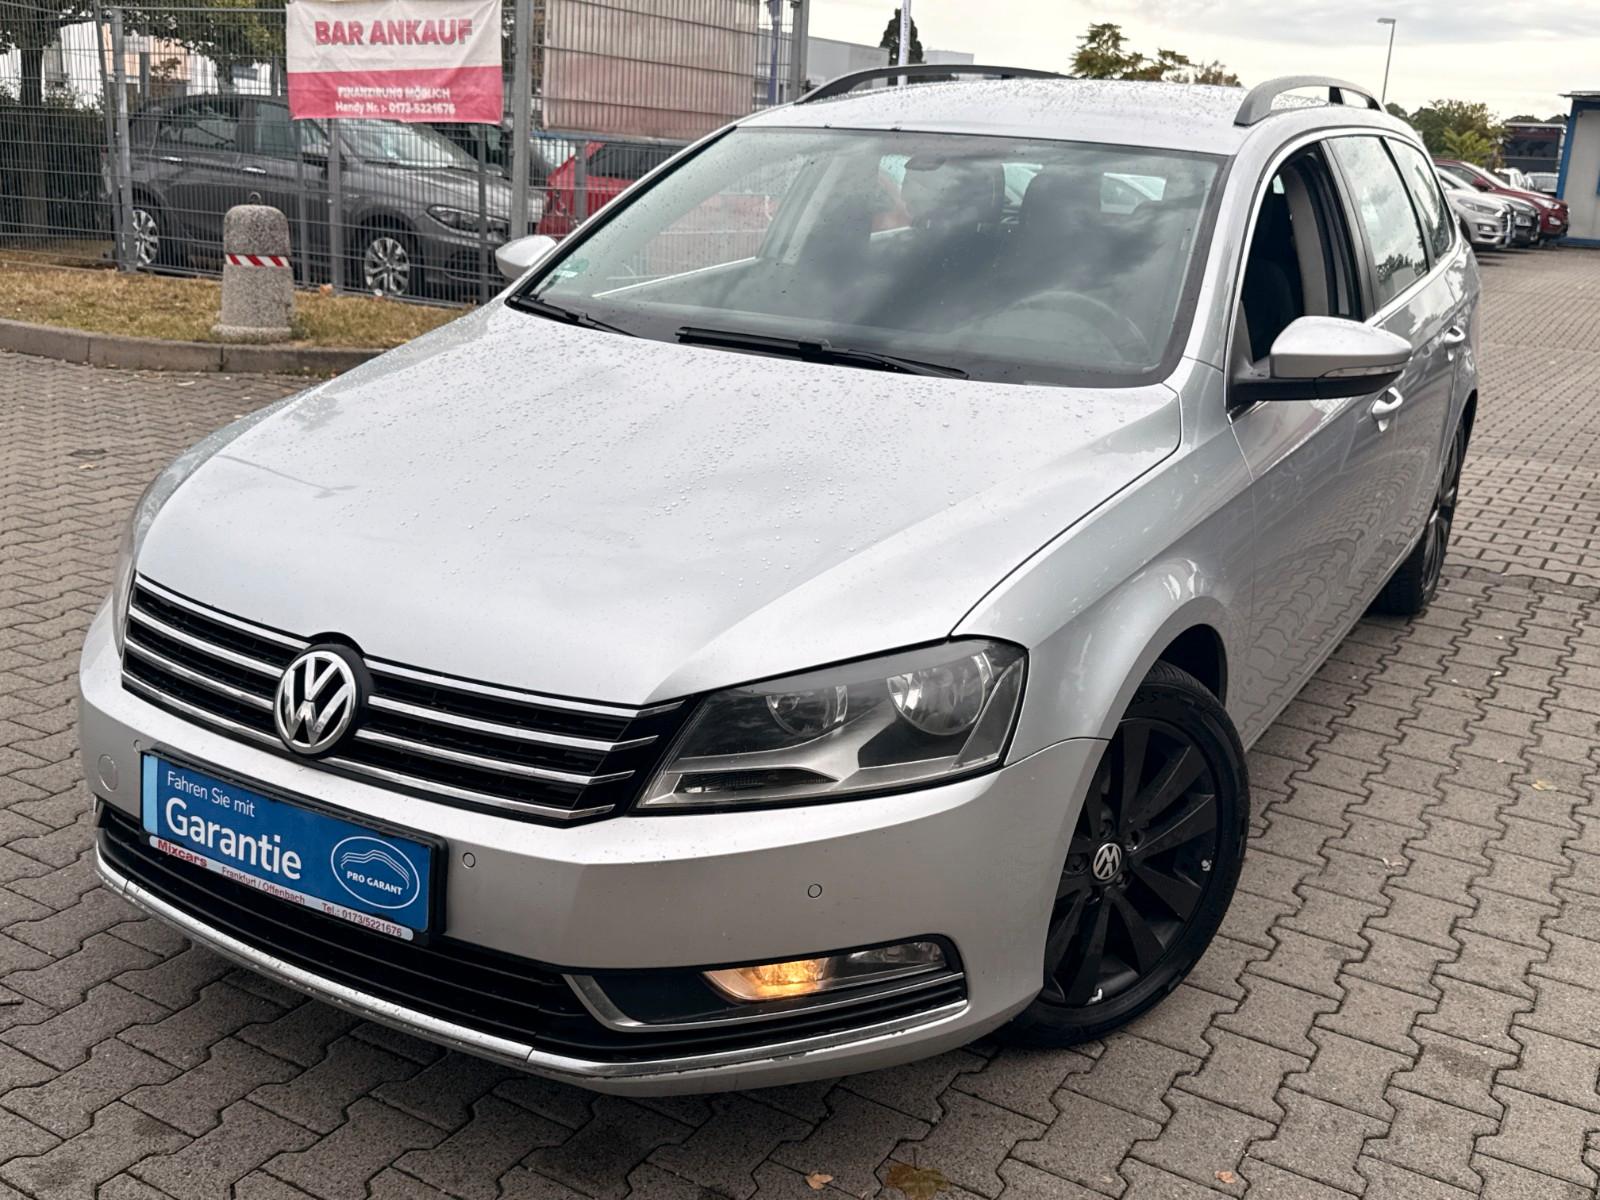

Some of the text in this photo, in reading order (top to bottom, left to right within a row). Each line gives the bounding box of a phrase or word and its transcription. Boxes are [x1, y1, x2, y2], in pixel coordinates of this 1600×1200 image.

[315, 18, 473, 46] BAR ANKAUF
[335, 101, 364, 114] Handy
[366, 102, 379, 113] Nr.
[388, 102, 456, 114] 0173-5221676
[405, 85, 450, 100] MÖGLICH
[277, 651, 355, 751] VW
[167, 771, 255, 818] Fahren Sie mit
[165, 796, 302, 880] Garantie
[157, 839, 208, 868] Mixcars
[221, 866, 257, 887] Frankfurt
[263, 882, 305, 905] Offenbach
[342, 910, 402, 937] 0173/5221676
[346, 870, 403, 896] PRO GARANT
